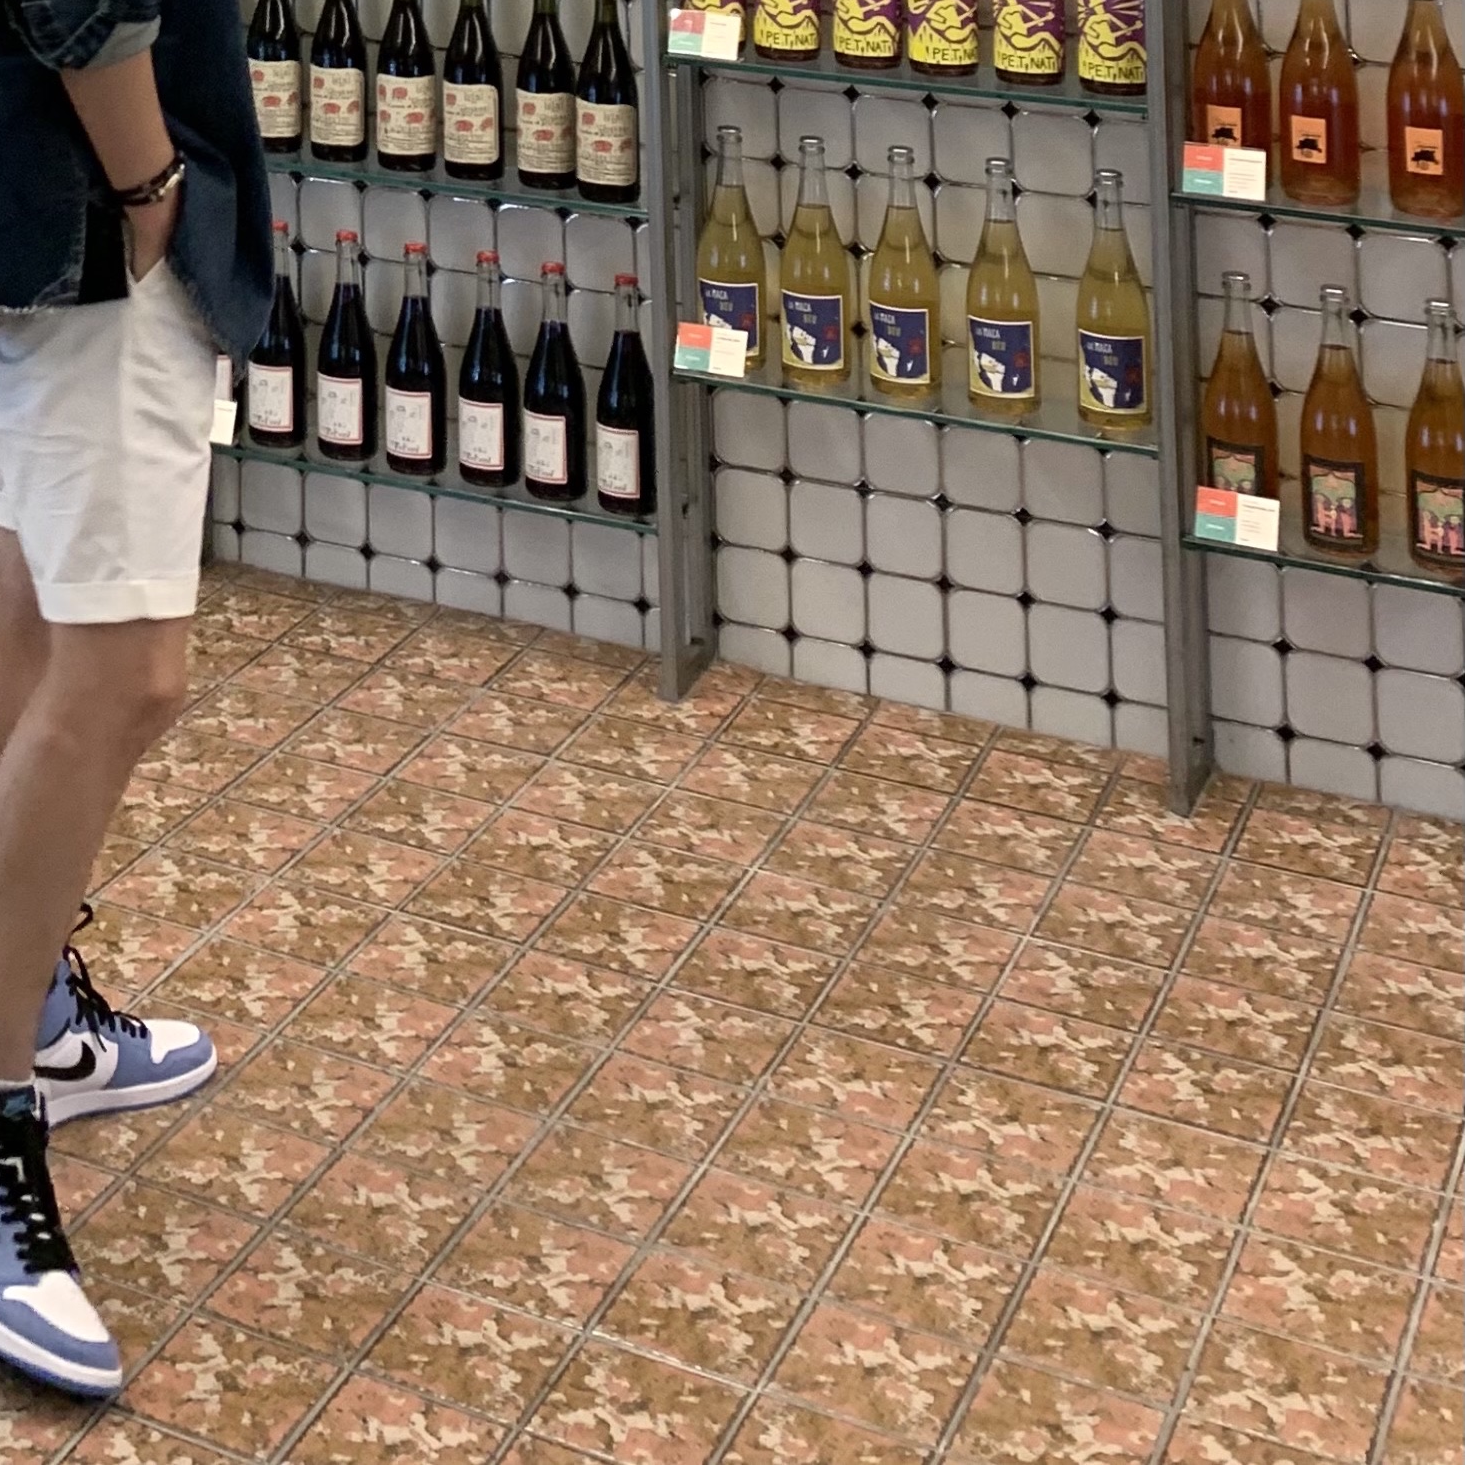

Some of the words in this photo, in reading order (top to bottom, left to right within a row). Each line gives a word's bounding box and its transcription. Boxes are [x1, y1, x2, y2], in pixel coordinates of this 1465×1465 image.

[795, 33, 817, 47] NAT
[865, 40, 890, 53] NAT
[1030, 56, 1053, 71] NAT
[1118, 65, 1143, 80] NAT
